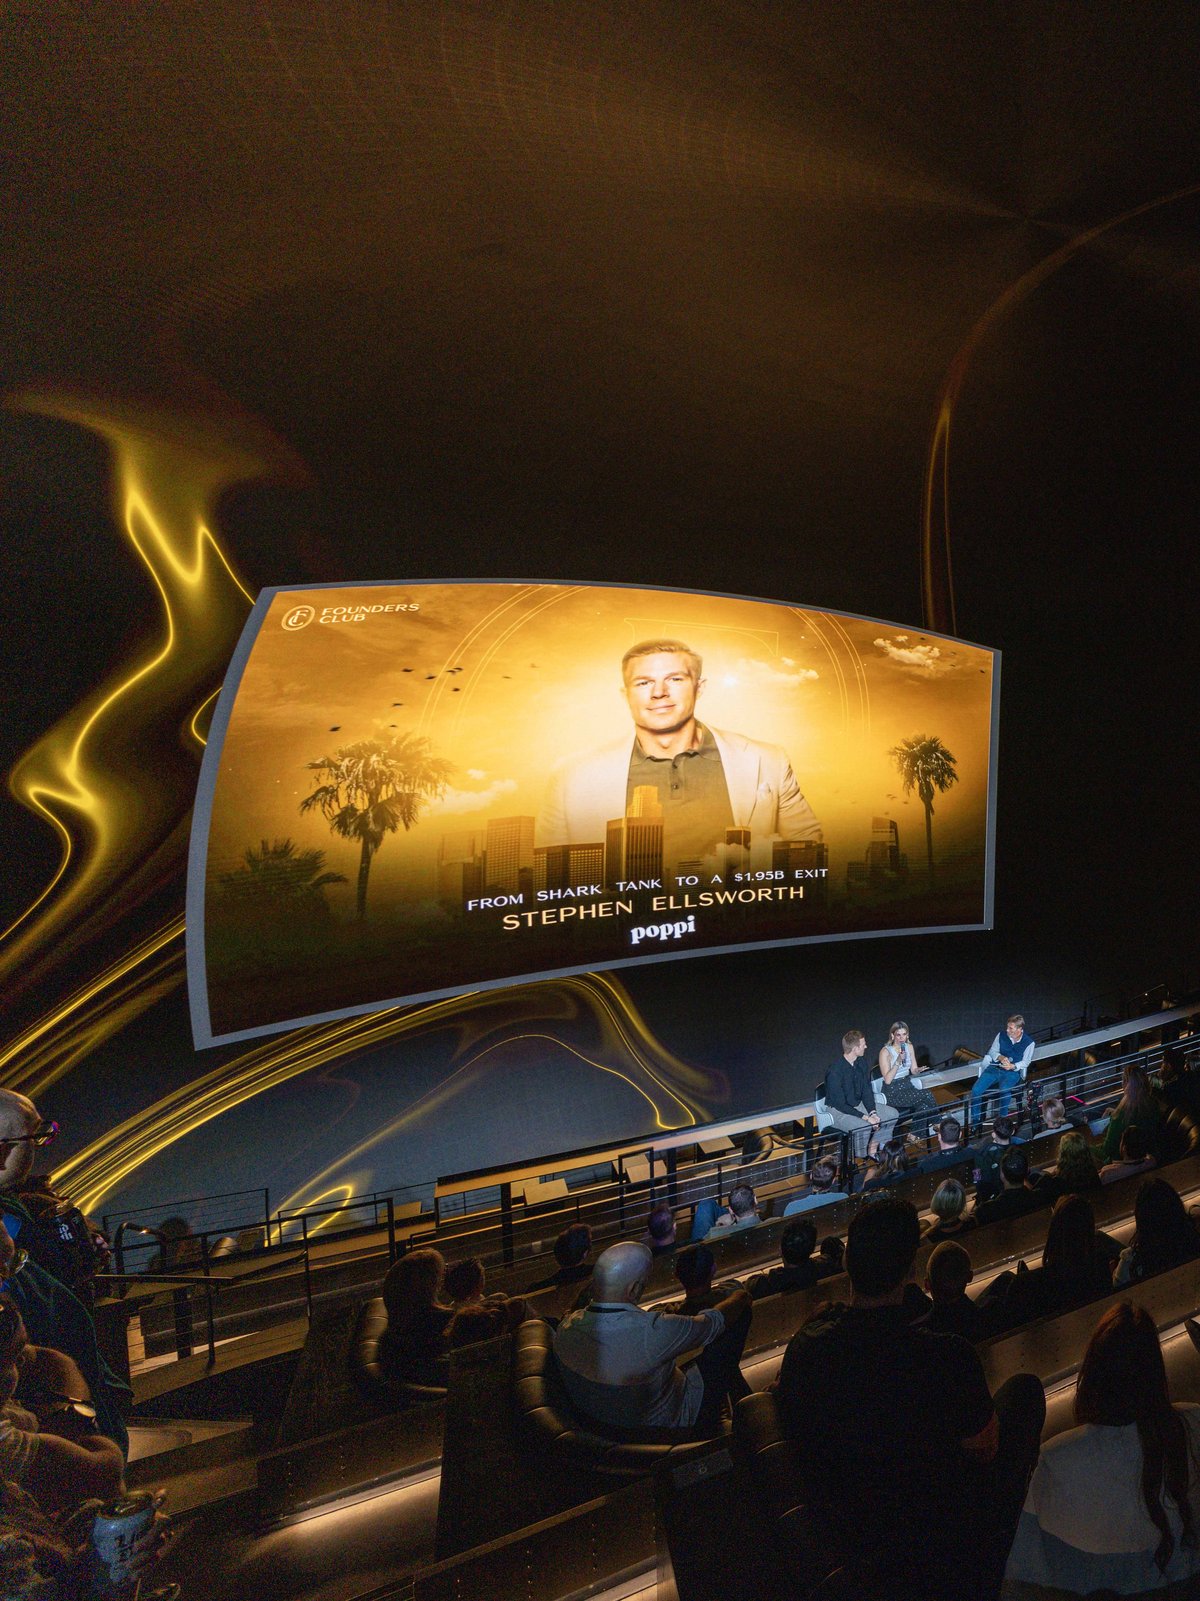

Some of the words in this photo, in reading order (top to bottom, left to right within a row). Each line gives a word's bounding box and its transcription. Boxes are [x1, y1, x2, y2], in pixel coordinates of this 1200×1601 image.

[319, 613, 366, 624] CLUB
[321, 603, 420, 616] FOUNDERS
[467, 893, 524, 911] FROM
[536, 884, 602, 902] SHARK
[616, 878, 662, 892] TANK
[675, 875, 699, 887] TO
[710, 874, 723, 884] A
[734, 870, 785, 882] $1.95B
[794, 868, 829, 879] EXIT
[502, 899, 634, 930] STEPHEN
[652, 886, 804, 912] ELLSWORTH
[630, 915, 696, 945] poppi
